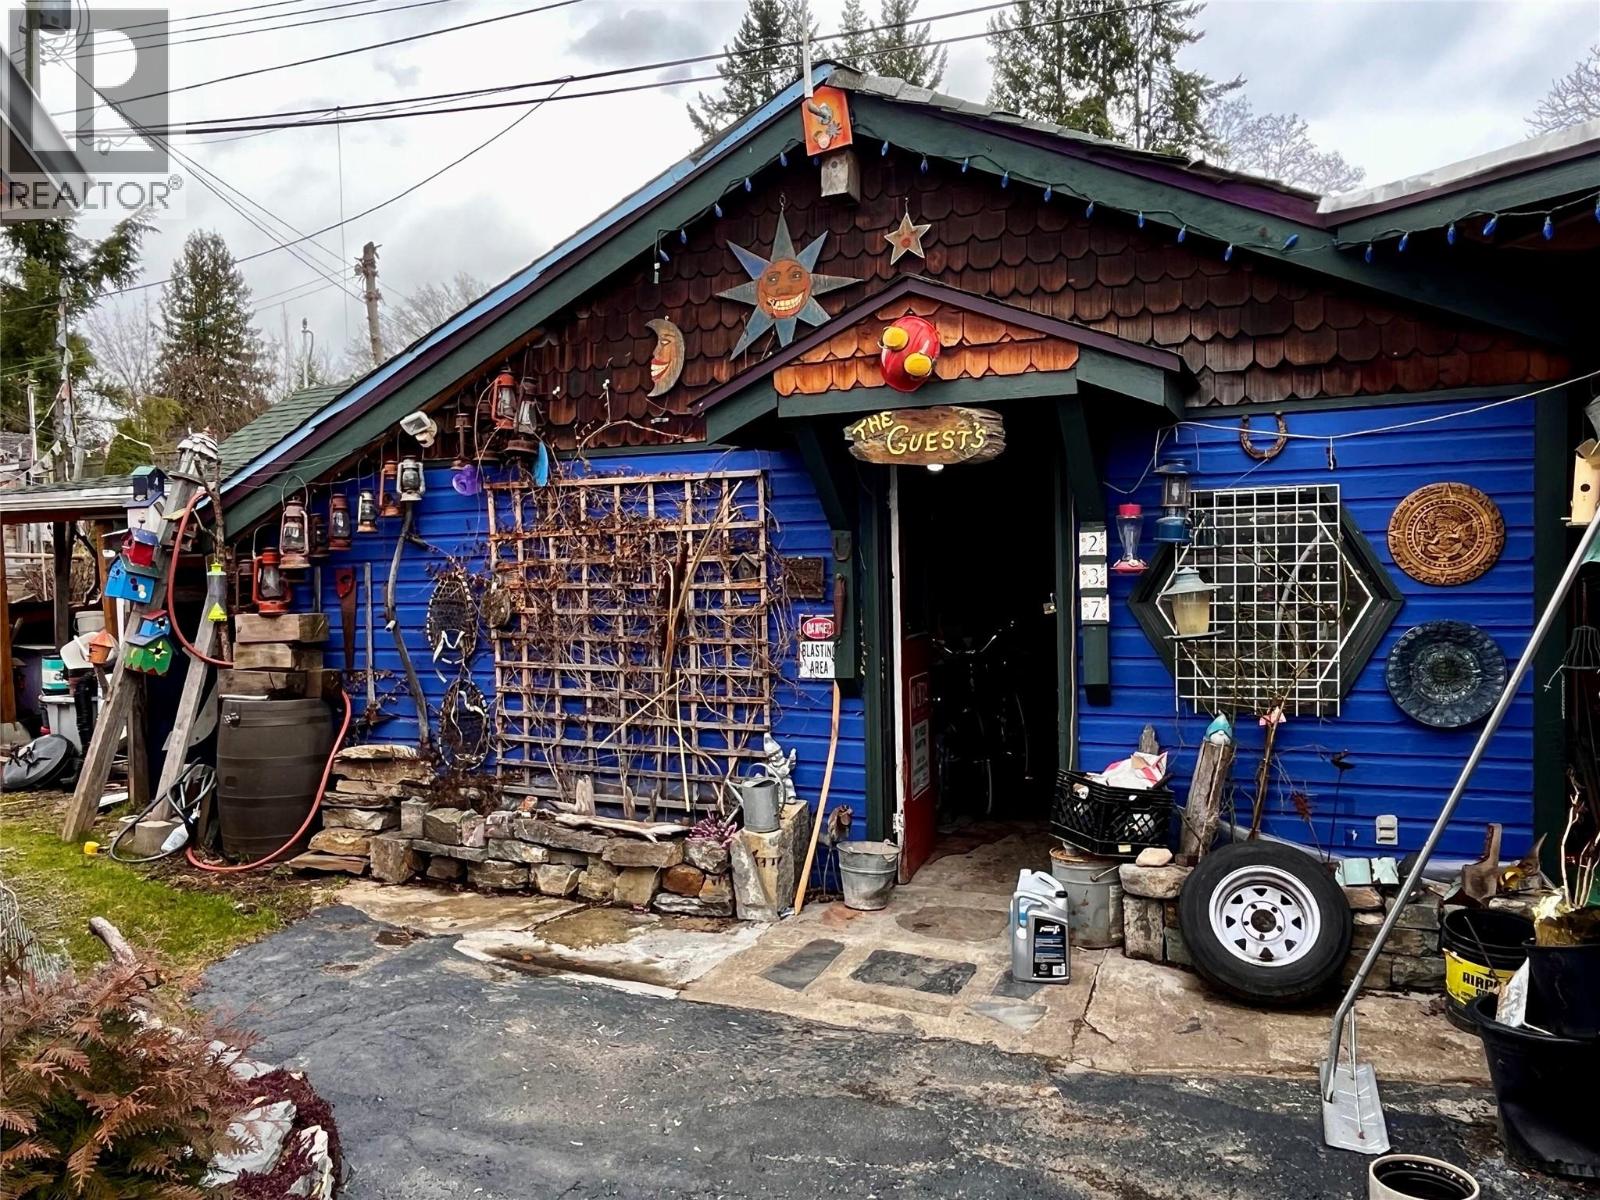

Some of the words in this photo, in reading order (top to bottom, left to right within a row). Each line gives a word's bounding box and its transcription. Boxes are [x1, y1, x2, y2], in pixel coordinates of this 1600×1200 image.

[852, 411, 894, 440] THE
[886, 422, 987, 455] GUEST'S
[810, 660, 829, 675] AREA
